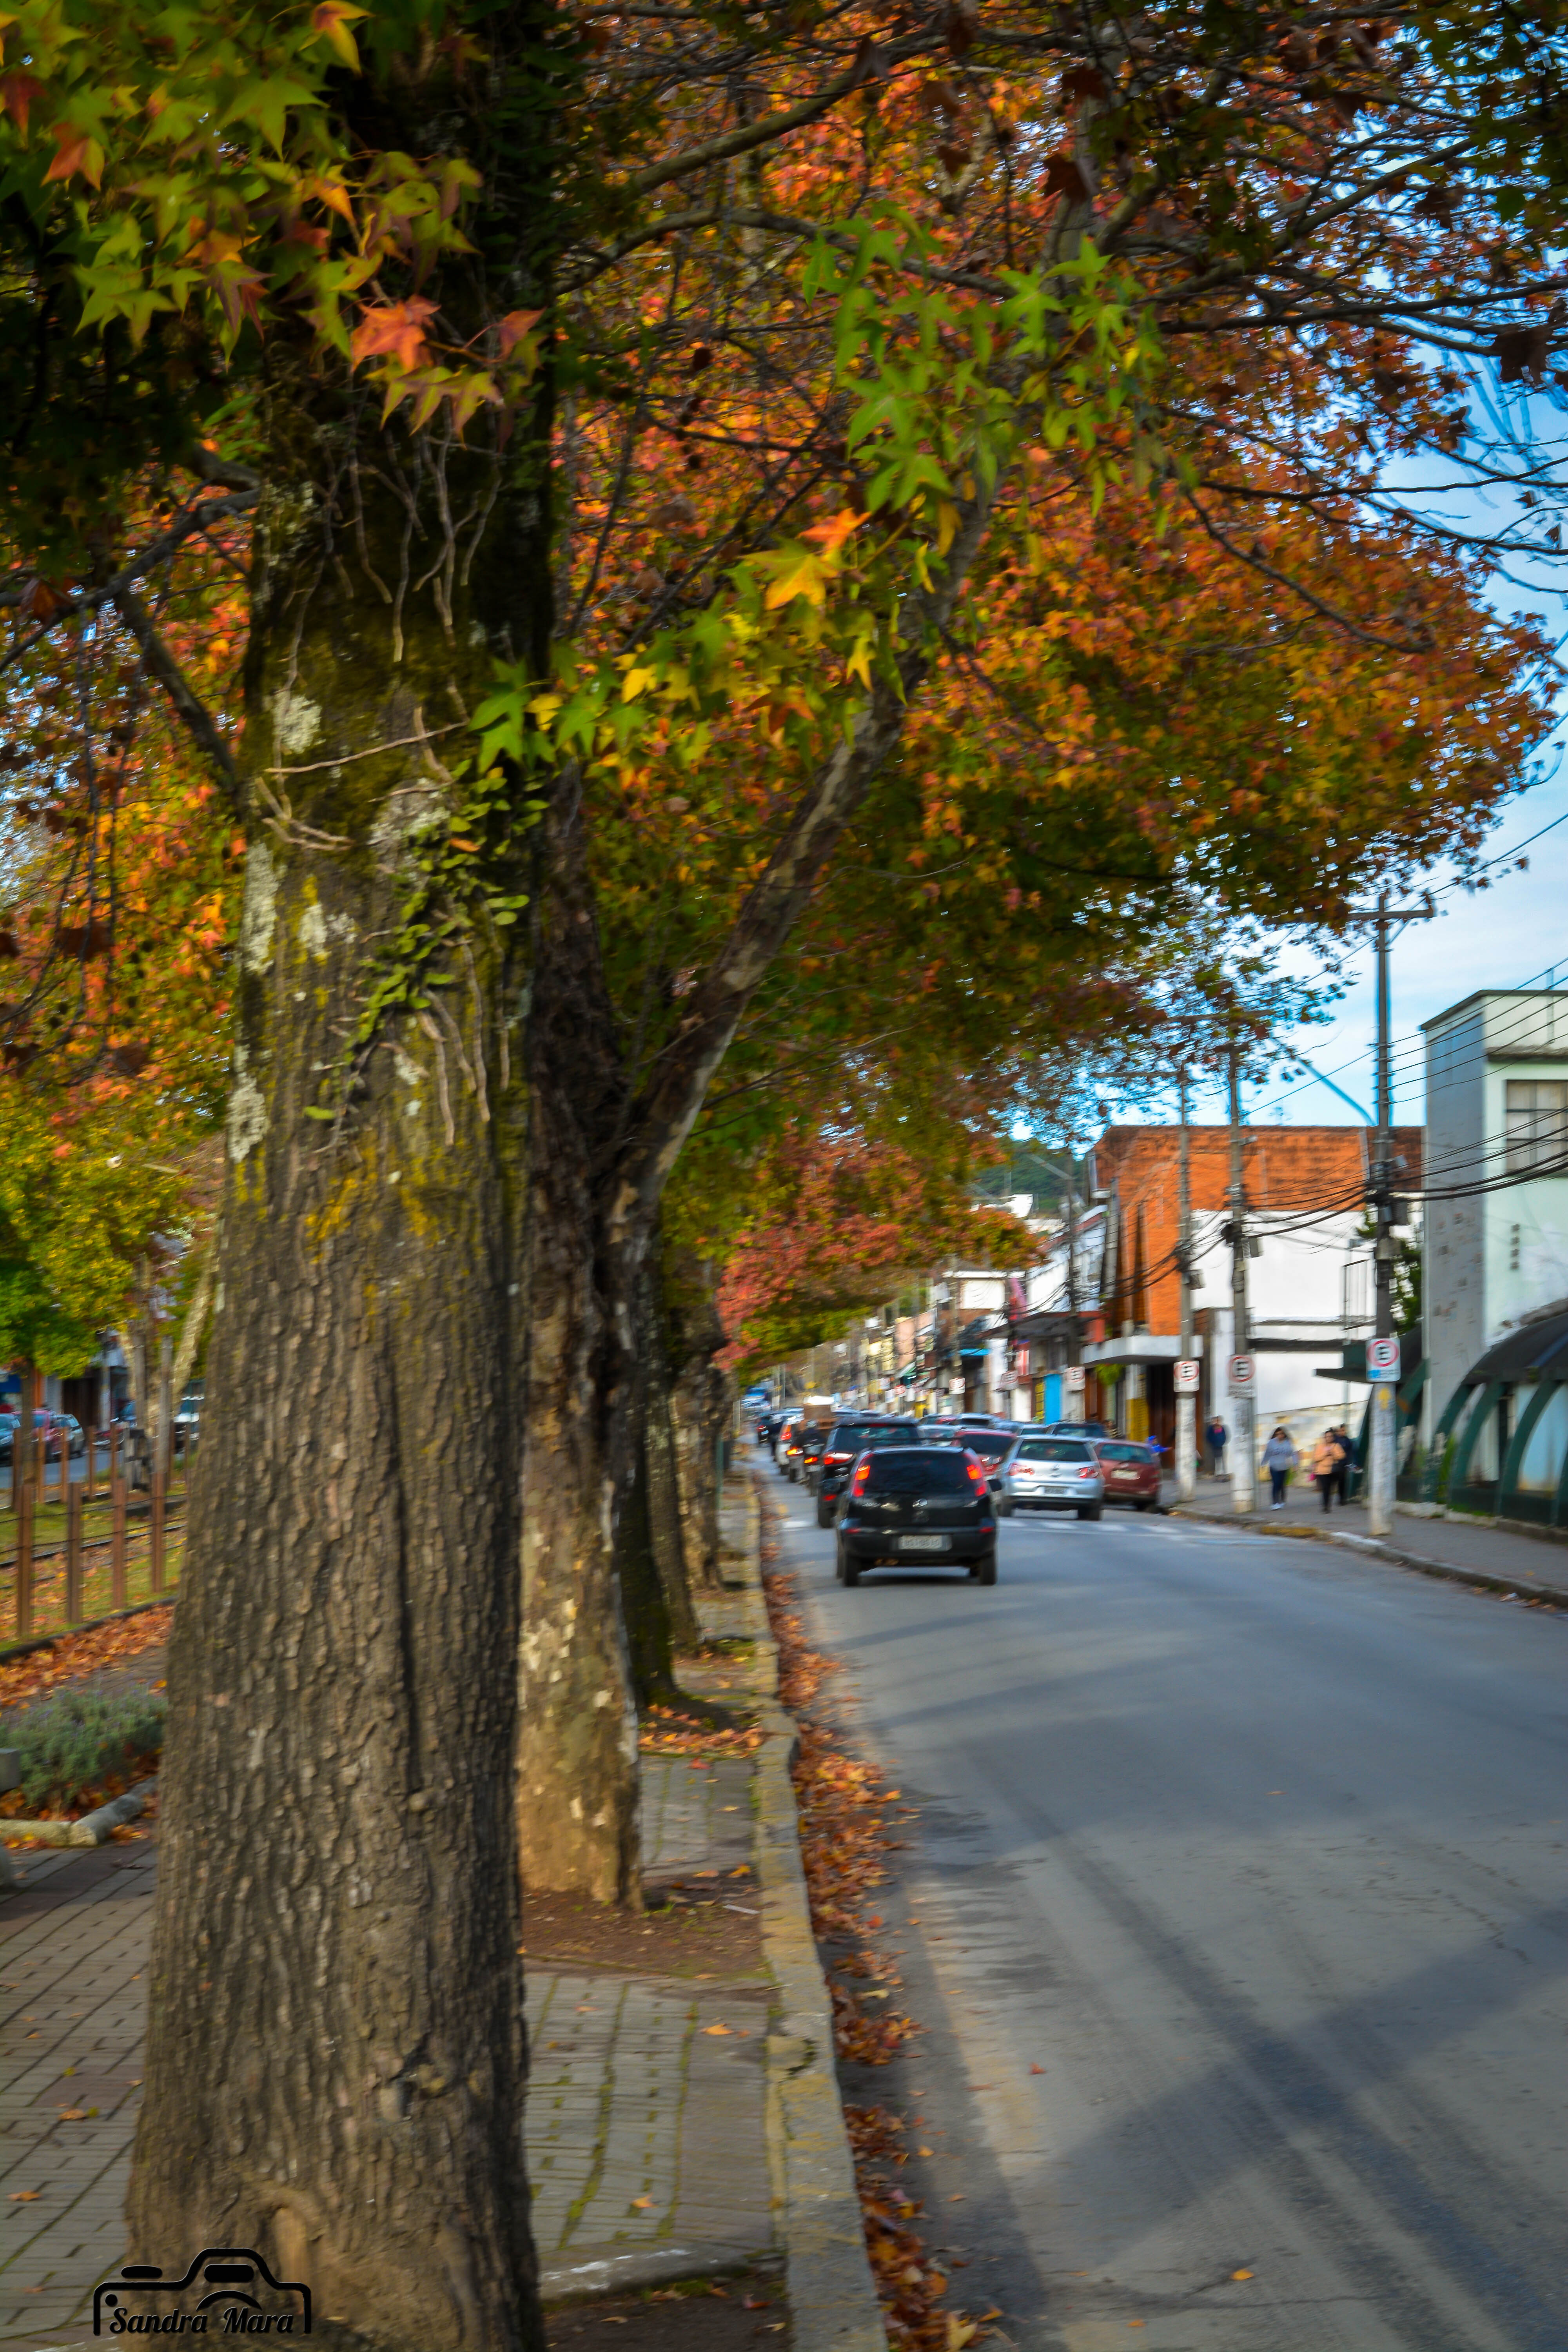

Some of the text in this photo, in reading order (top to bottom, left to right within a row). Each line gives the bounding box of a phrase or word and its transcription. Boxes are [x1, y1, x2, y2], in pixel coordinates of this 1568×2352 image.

[1377, 1346, 1390, 1361] E
[1182, 1366, 1193, 1377] E
[1235, 1361, 1248, 1376] E
